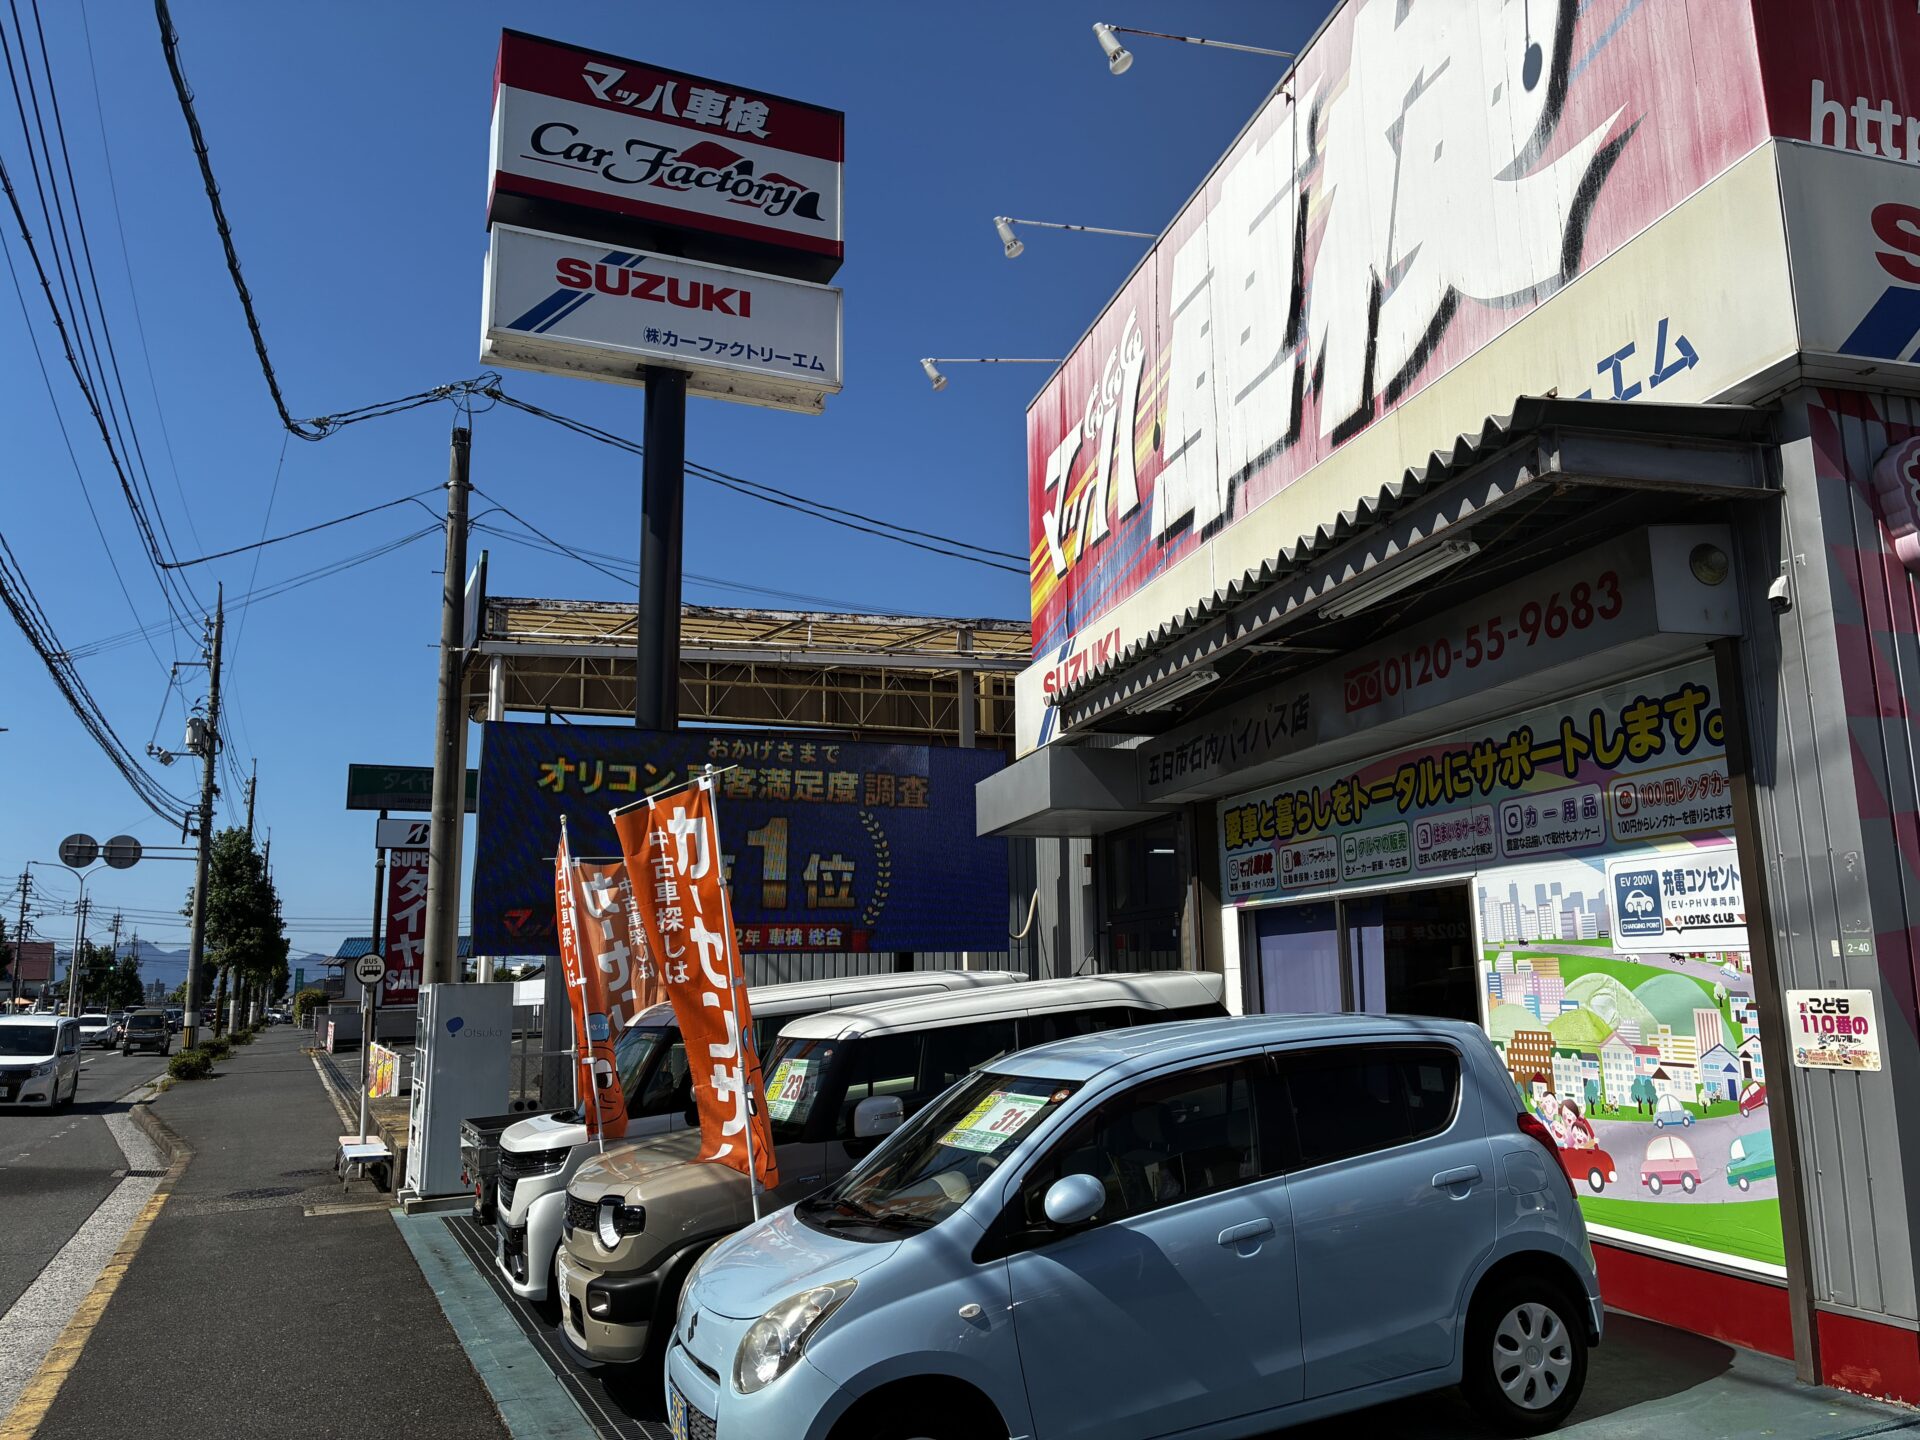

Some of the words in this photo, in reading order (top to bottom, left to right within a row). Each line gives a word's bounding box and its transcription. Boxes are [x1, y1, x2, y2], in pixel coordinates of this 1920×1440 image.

[582, 61, 772, 140] マッハ車検
[530, 122, 613, 167] Car
[603, 138, 798, 217] Factory
[555, 256, 752, 318] SUZUKI
[1382, 569, 1624, 698] 0120-55-9683
[708, 738, 840, 765] おかげさまで
[1148, 693, 1310, 786] 五日市石内バイパス店
[537, 757, 676, 795] オリコン
[863, 772, 929, 808] 調査
[1224, 683, 1727, 852] 愛車と暮らしをトータルにサポートします。
[1358, 830, 1408, 858] クルマの販売
[1620, 878, 1631, 887] EV
[1633, 875, 1653, 886] 200V
[1662, 864, 1740, 897] 充電コンセント
[648, 826, 690, 984] 中古車探しは
[1684, 914, 1711, 925] LOTAS
[1713, 912, 1735, 924] CLUB
[364, 957, 378, 965] BUS
[1847, 943, 1870, 953] 2-40
[1808, 997, 1850, 1014] こども
[1800, 1014, 1869, 1035] 110番の
